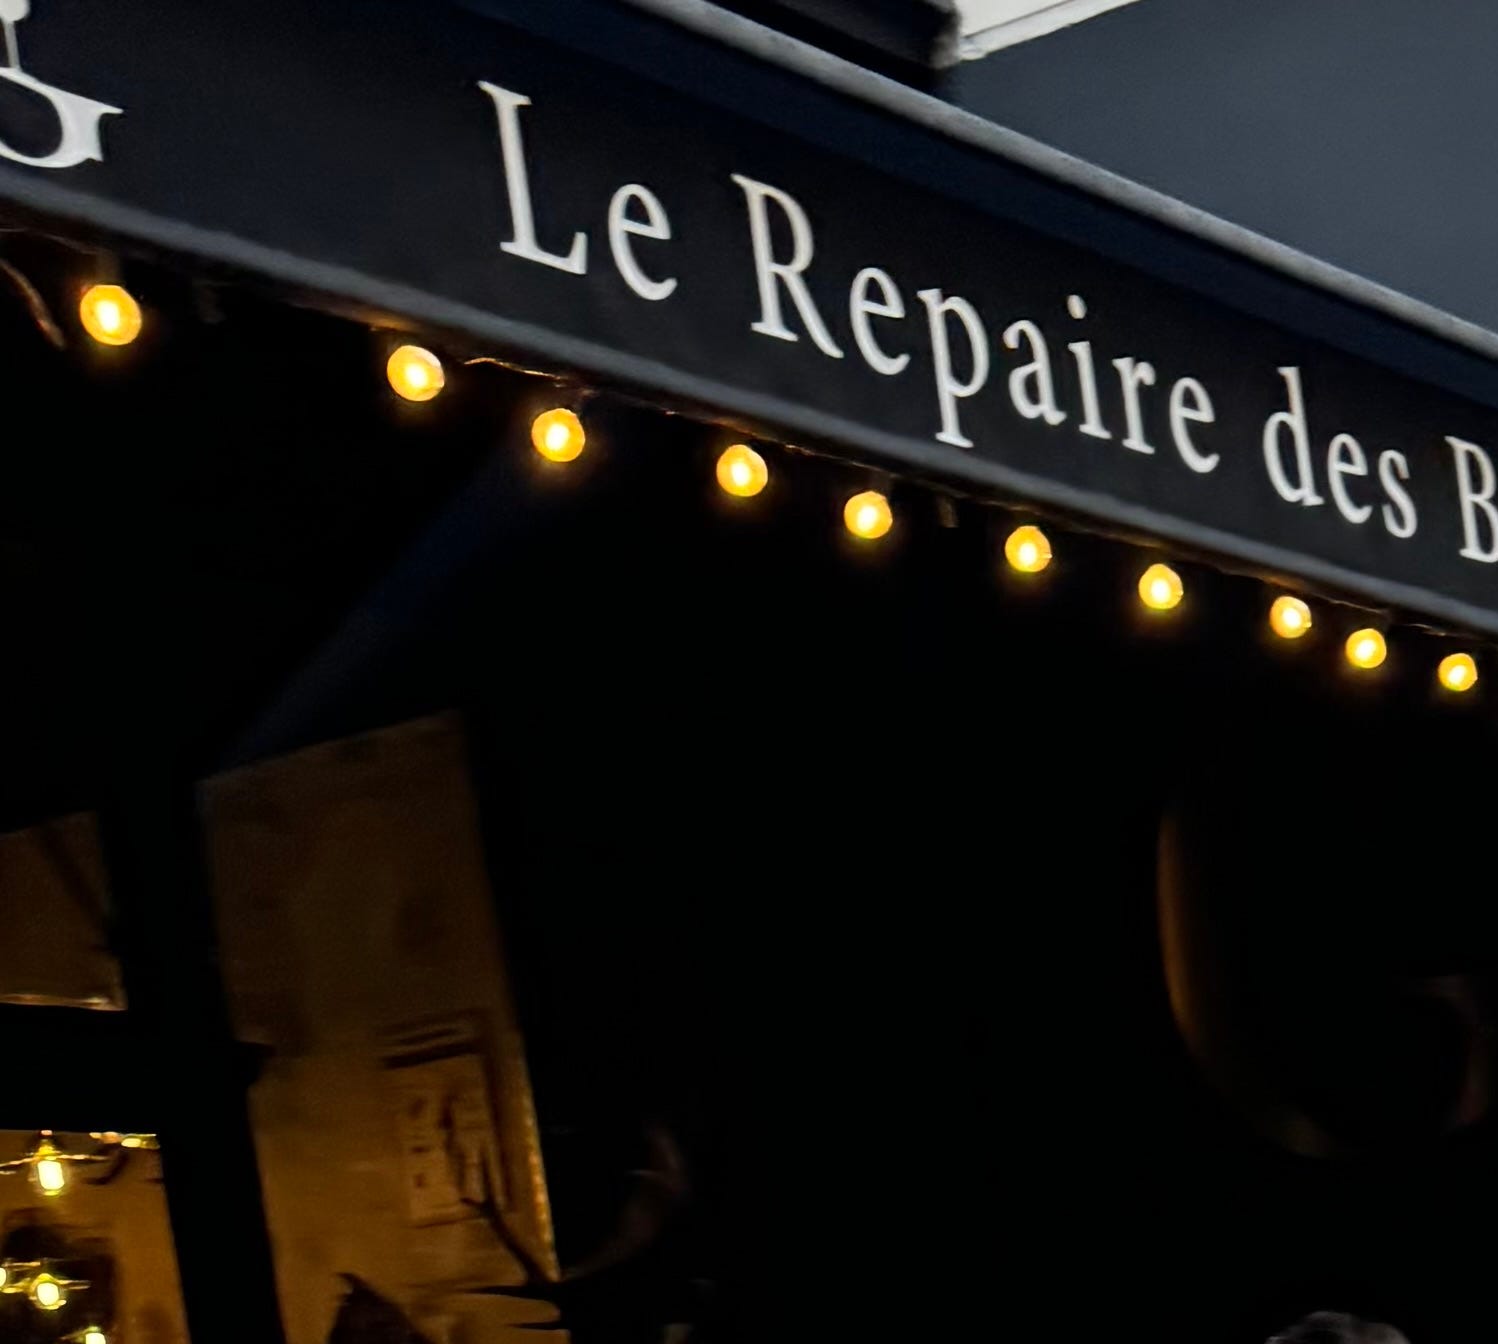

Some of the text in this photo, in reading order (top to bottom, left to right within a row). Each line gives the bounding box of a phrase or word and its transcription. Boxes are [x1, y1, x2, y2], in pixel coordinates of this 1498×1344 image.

[477, 80, 678, 303] Le
[730, 172, 1221, 475] Repaire
[1262, 365, 1418, 540] des
